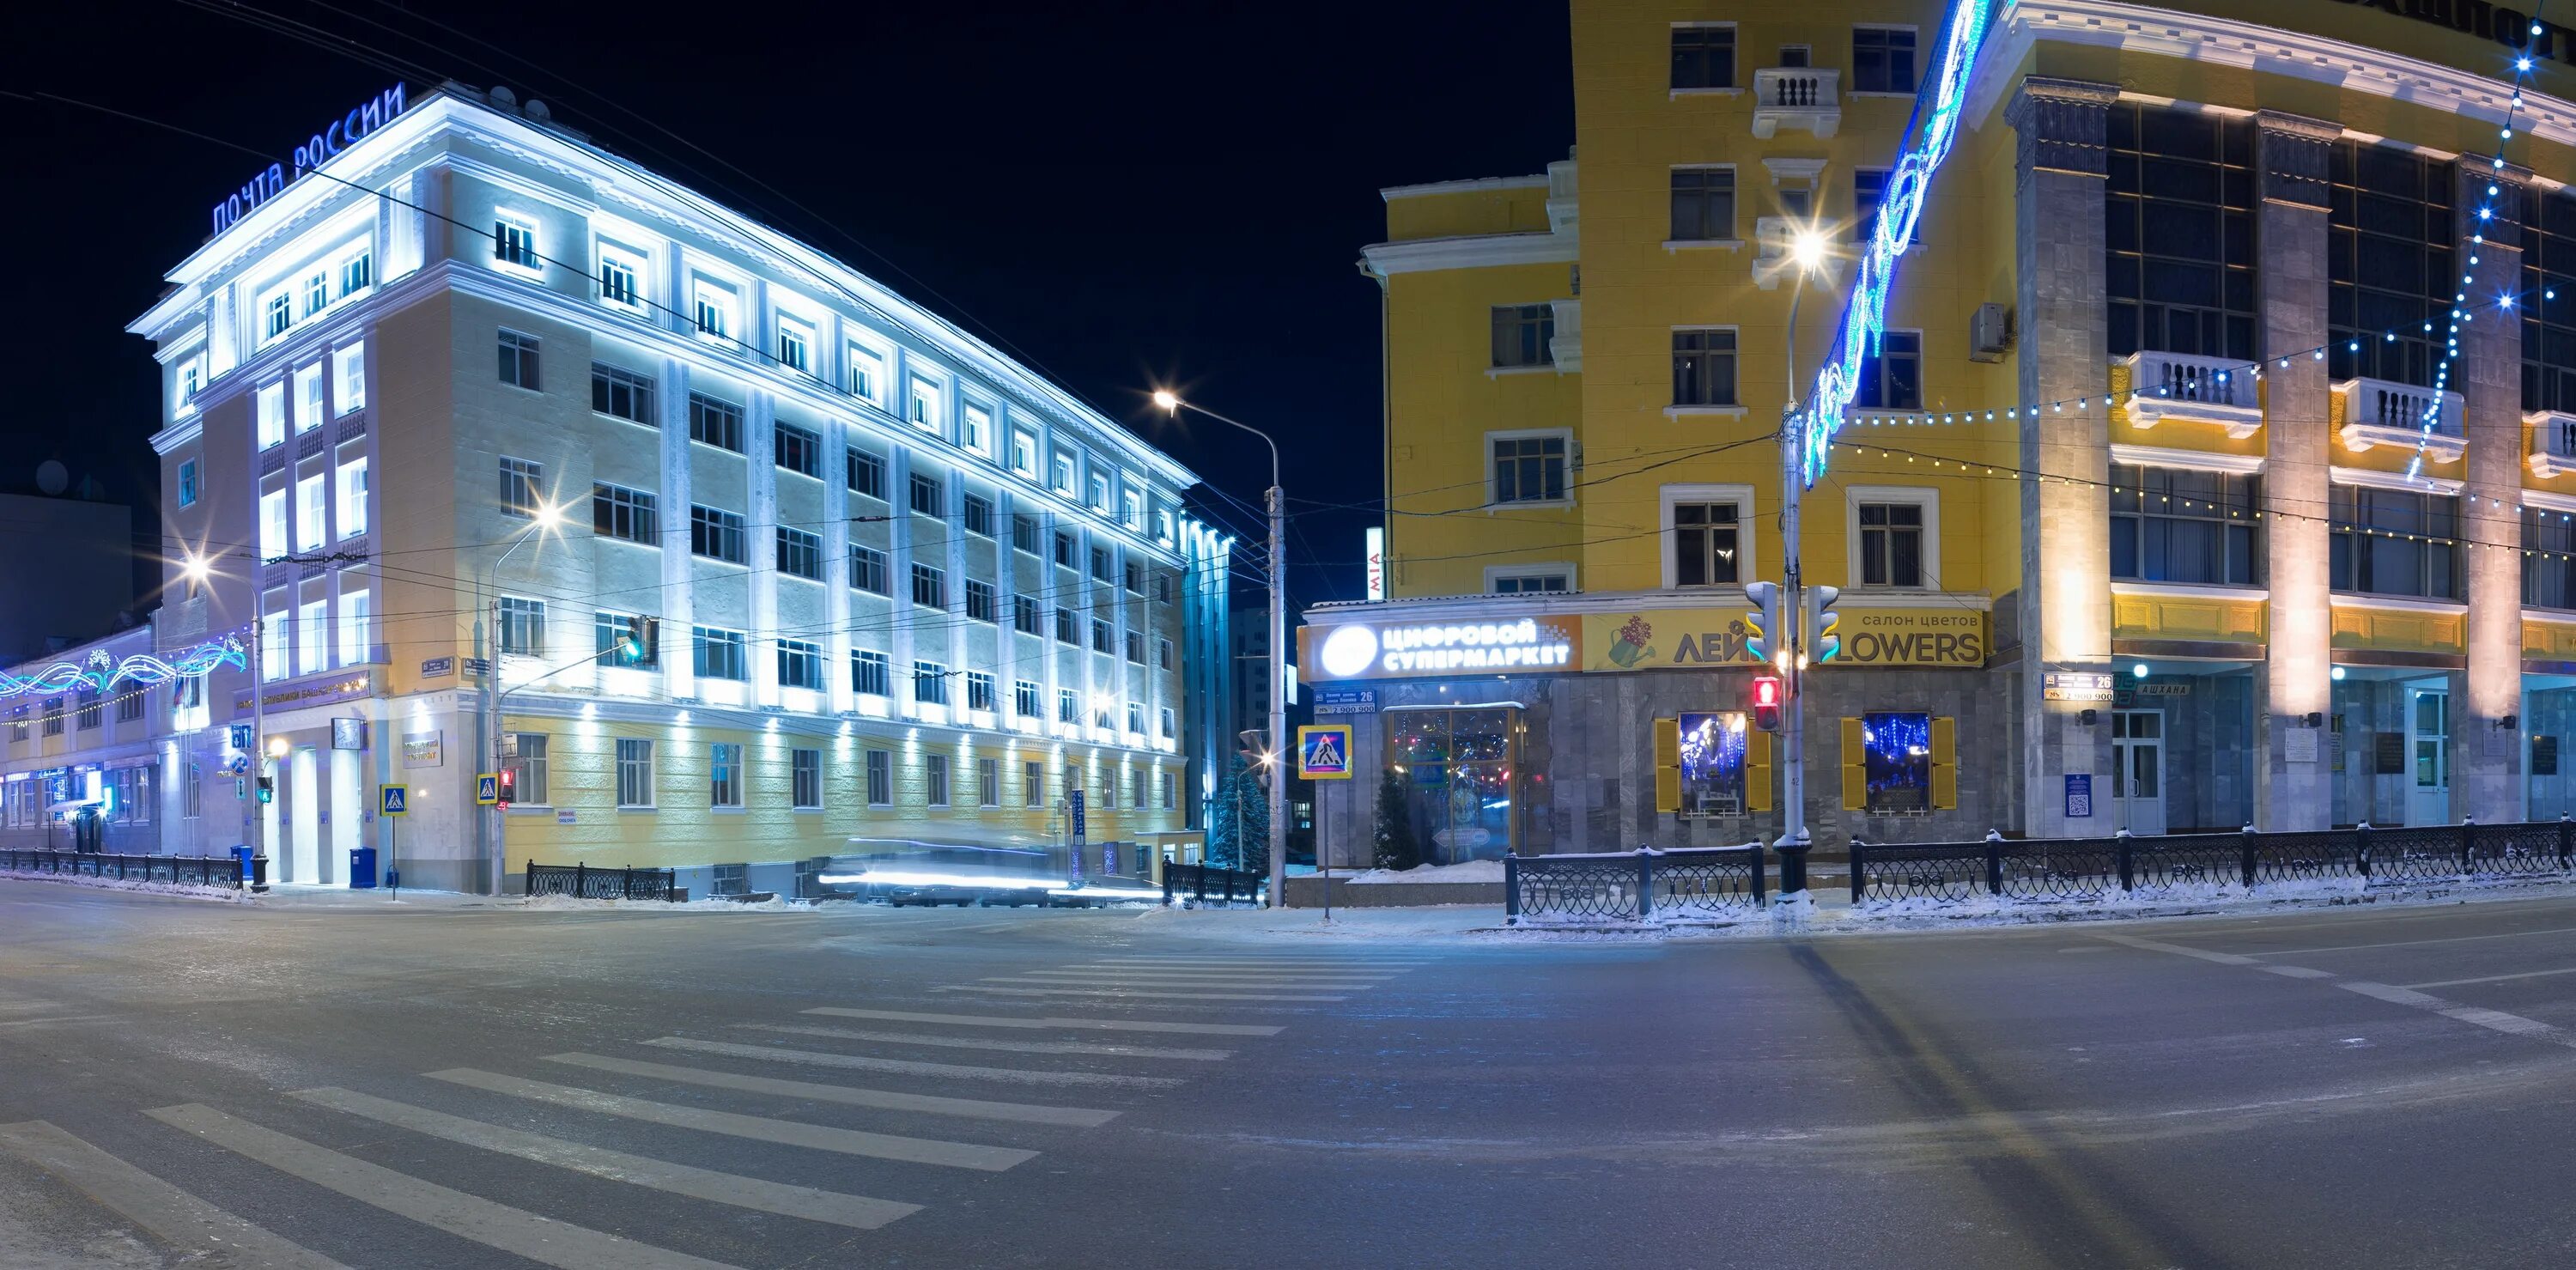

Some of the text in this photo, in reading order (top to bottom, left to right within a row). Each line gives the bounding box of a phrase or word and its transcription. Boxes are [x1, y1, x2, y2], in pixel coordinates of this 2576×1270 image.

[213, 82, 405, 235] ПОЧТА РОССИИ
[1369, 552, 1380, 592] MIA
[1383, 618, 1536, 651] ЦИФРОВОЙ
[1862, 615, 1978, 627] салон цветов
[1674, 619, 1763, 663] ЛЕЙ
[1833, 632, 1982, 663] LOWERS
[1383, 644, 1570, 671] СУПЕРМАРКЕТ
[2097, 676, 2111, 689] 26
[2142, 686, 2186, 695] АШХАНА
[1360, 691, 1373, 702] 26
[1791, 776, 1800, 787] 42
